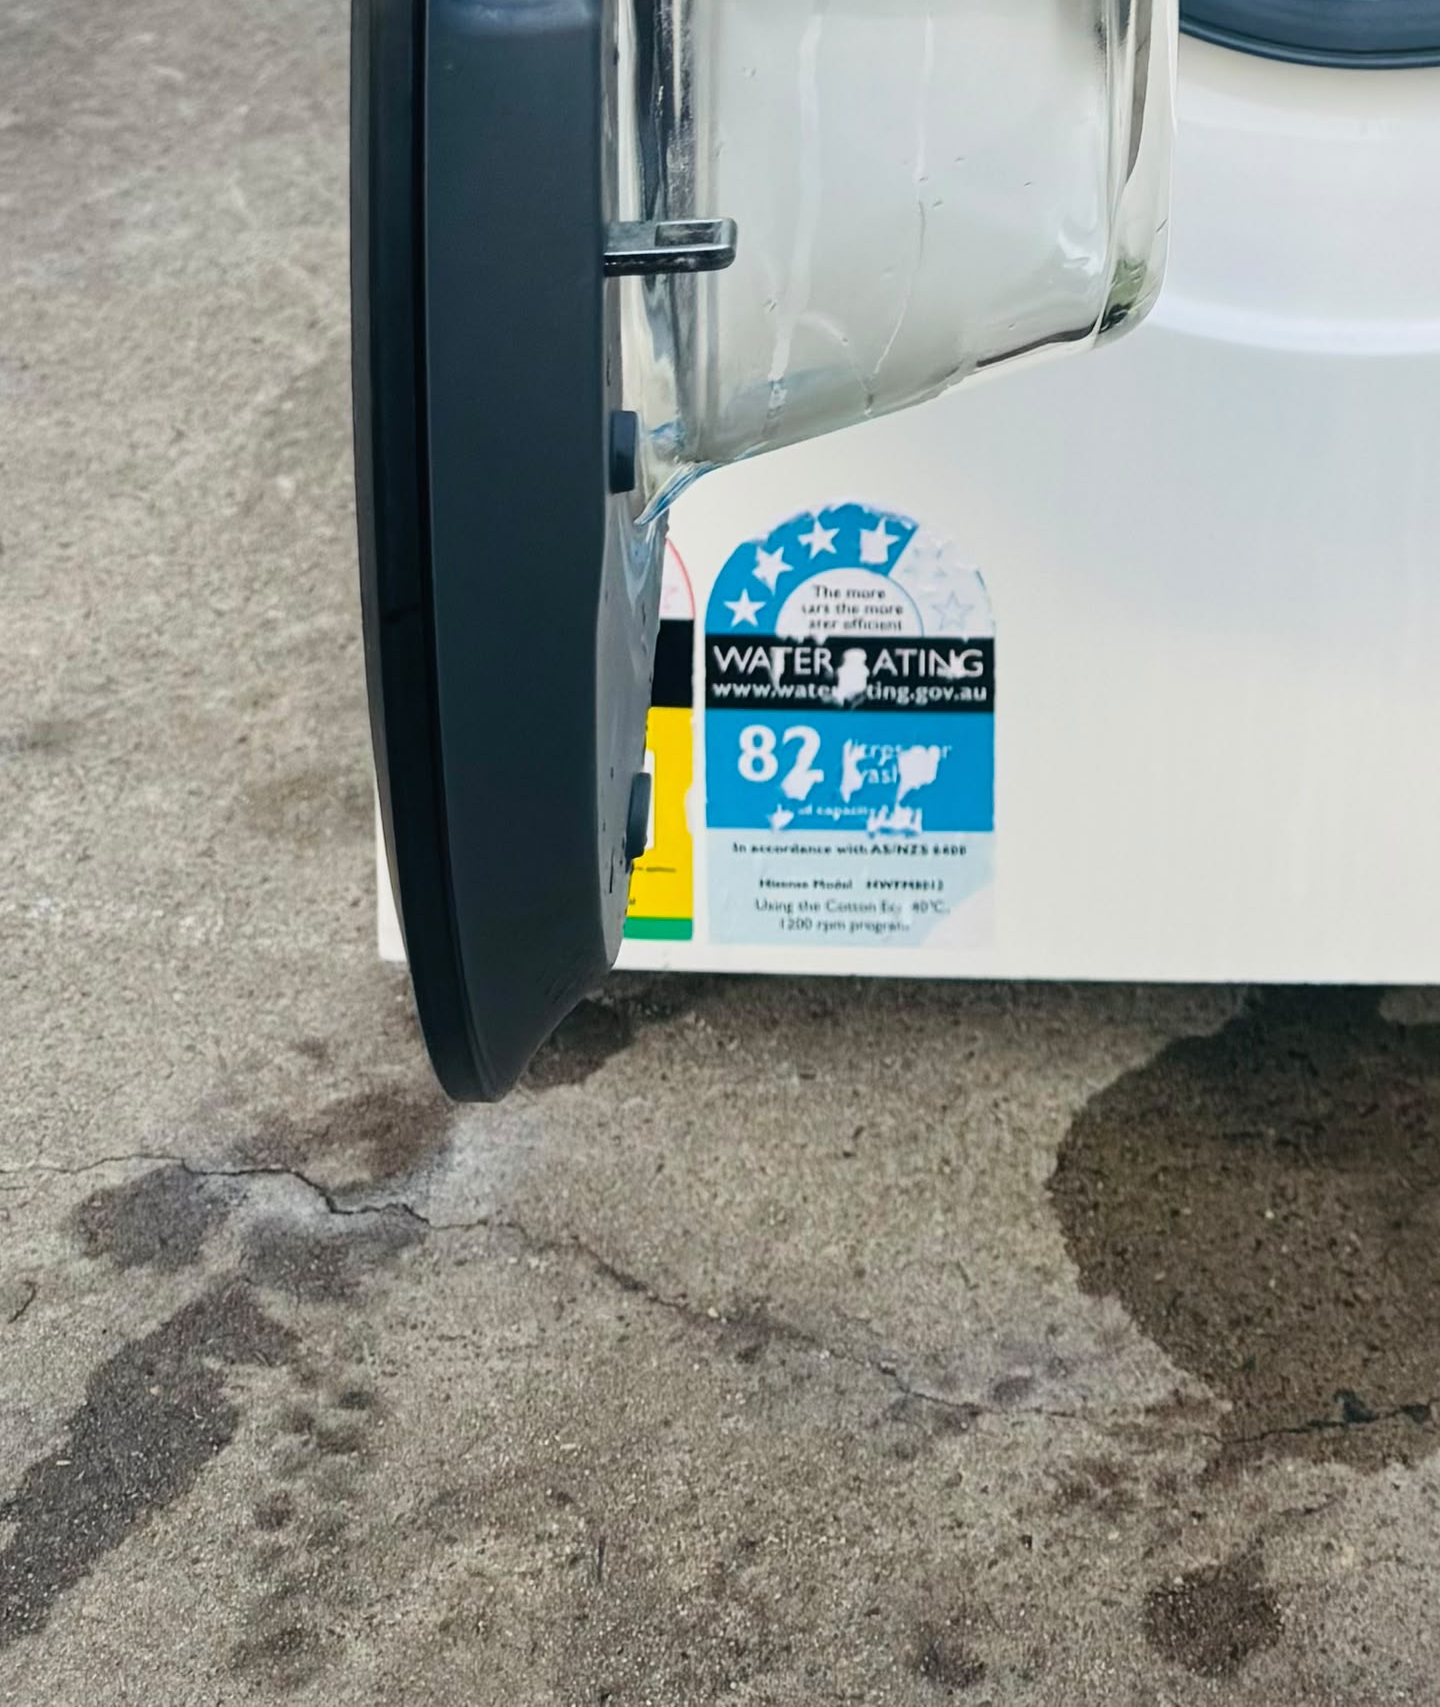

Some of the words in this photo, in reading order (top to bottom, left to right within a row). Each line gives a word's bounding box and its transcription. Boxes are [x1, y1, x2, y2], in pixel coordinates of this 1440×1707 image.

[812, 585, 841, 599] The
[846, 587, 885, 599] more
[836, 602, 860, 615] the
[864, 604, 903, 616] more
[712, 644, 834, 677] WATER
[841, 647, 984, 678] ATING
[738, 725, 824, 784] 82
[755, 898, 793, 914] Using
[798, 898, 824, 912] the
[826, 898, 877, 913] Cotton
[779, 918, 813, 931] 1200
[817, 920, 846, 934] rpm
